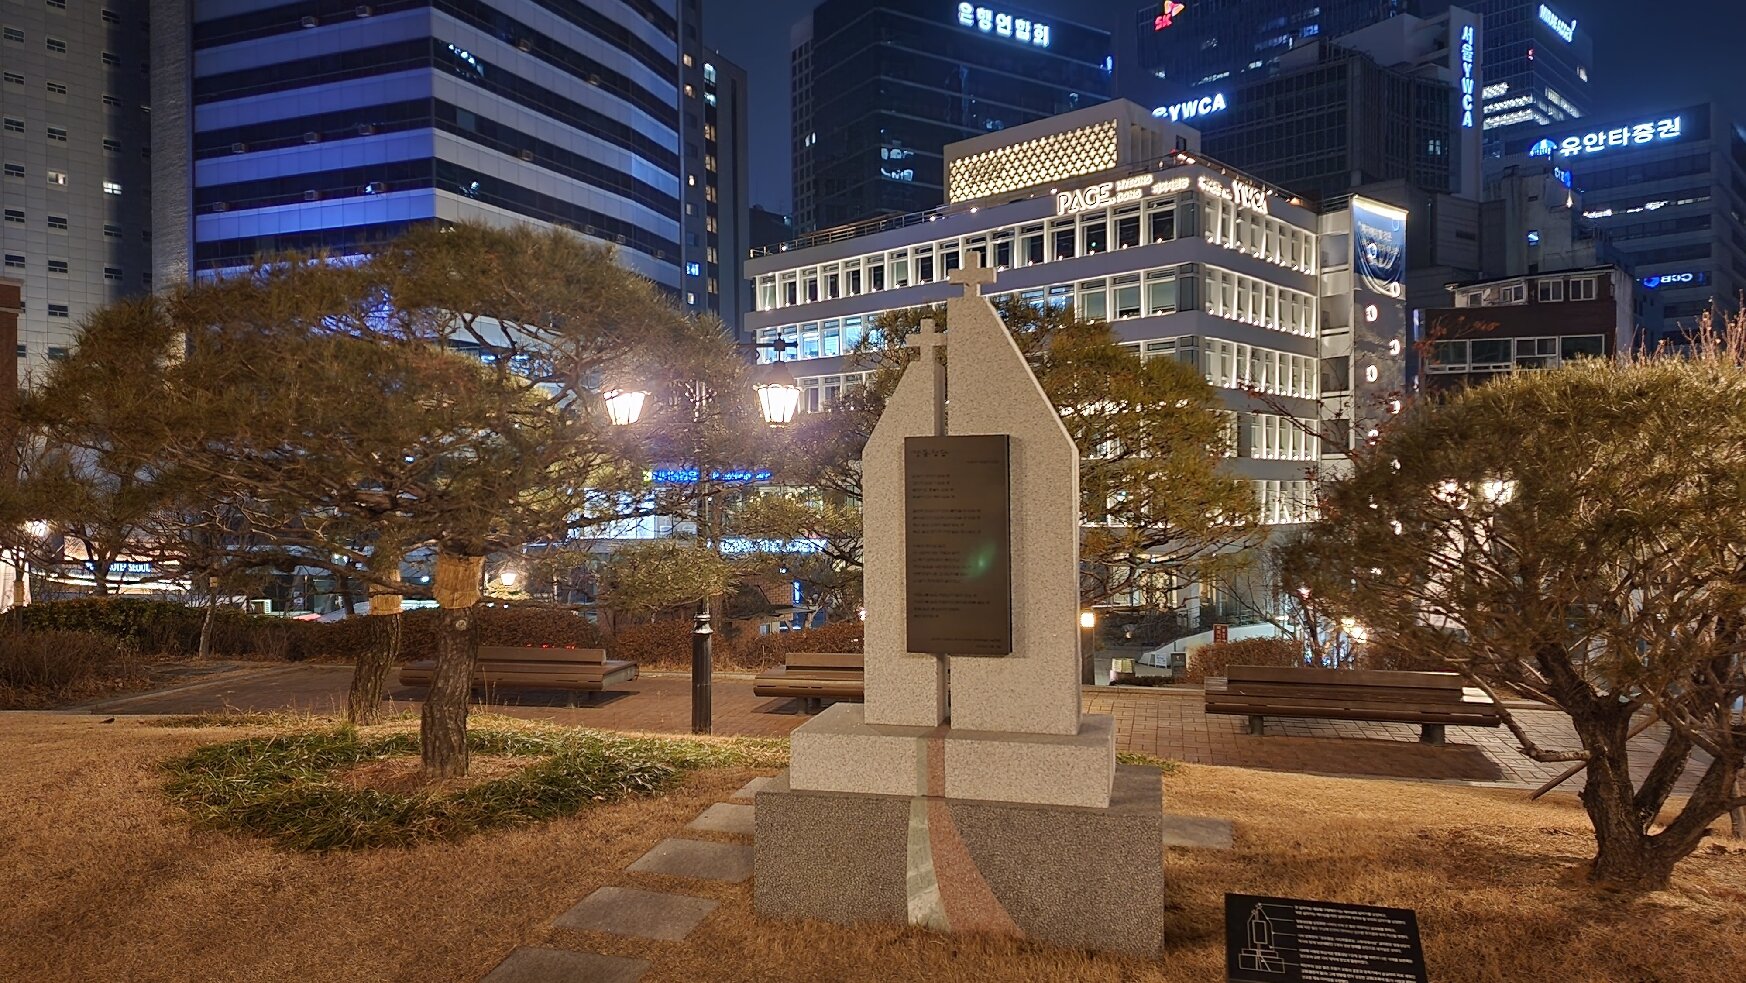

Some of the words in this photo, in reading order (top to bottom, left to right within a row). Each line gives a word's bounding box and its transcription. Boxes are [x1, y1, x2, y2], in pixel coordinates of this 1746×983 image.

[958, 2, 1050, 47] 은행연합회
[1154, 13, 1173, 31] SK
[1461, 26, 1475, 128] 서울YWCA
[1559, 115, 1682, 157] 유안타증권
[1056, 181, 1115, 215] PAGE
[1232, 178, 1269, 215] YWCA
